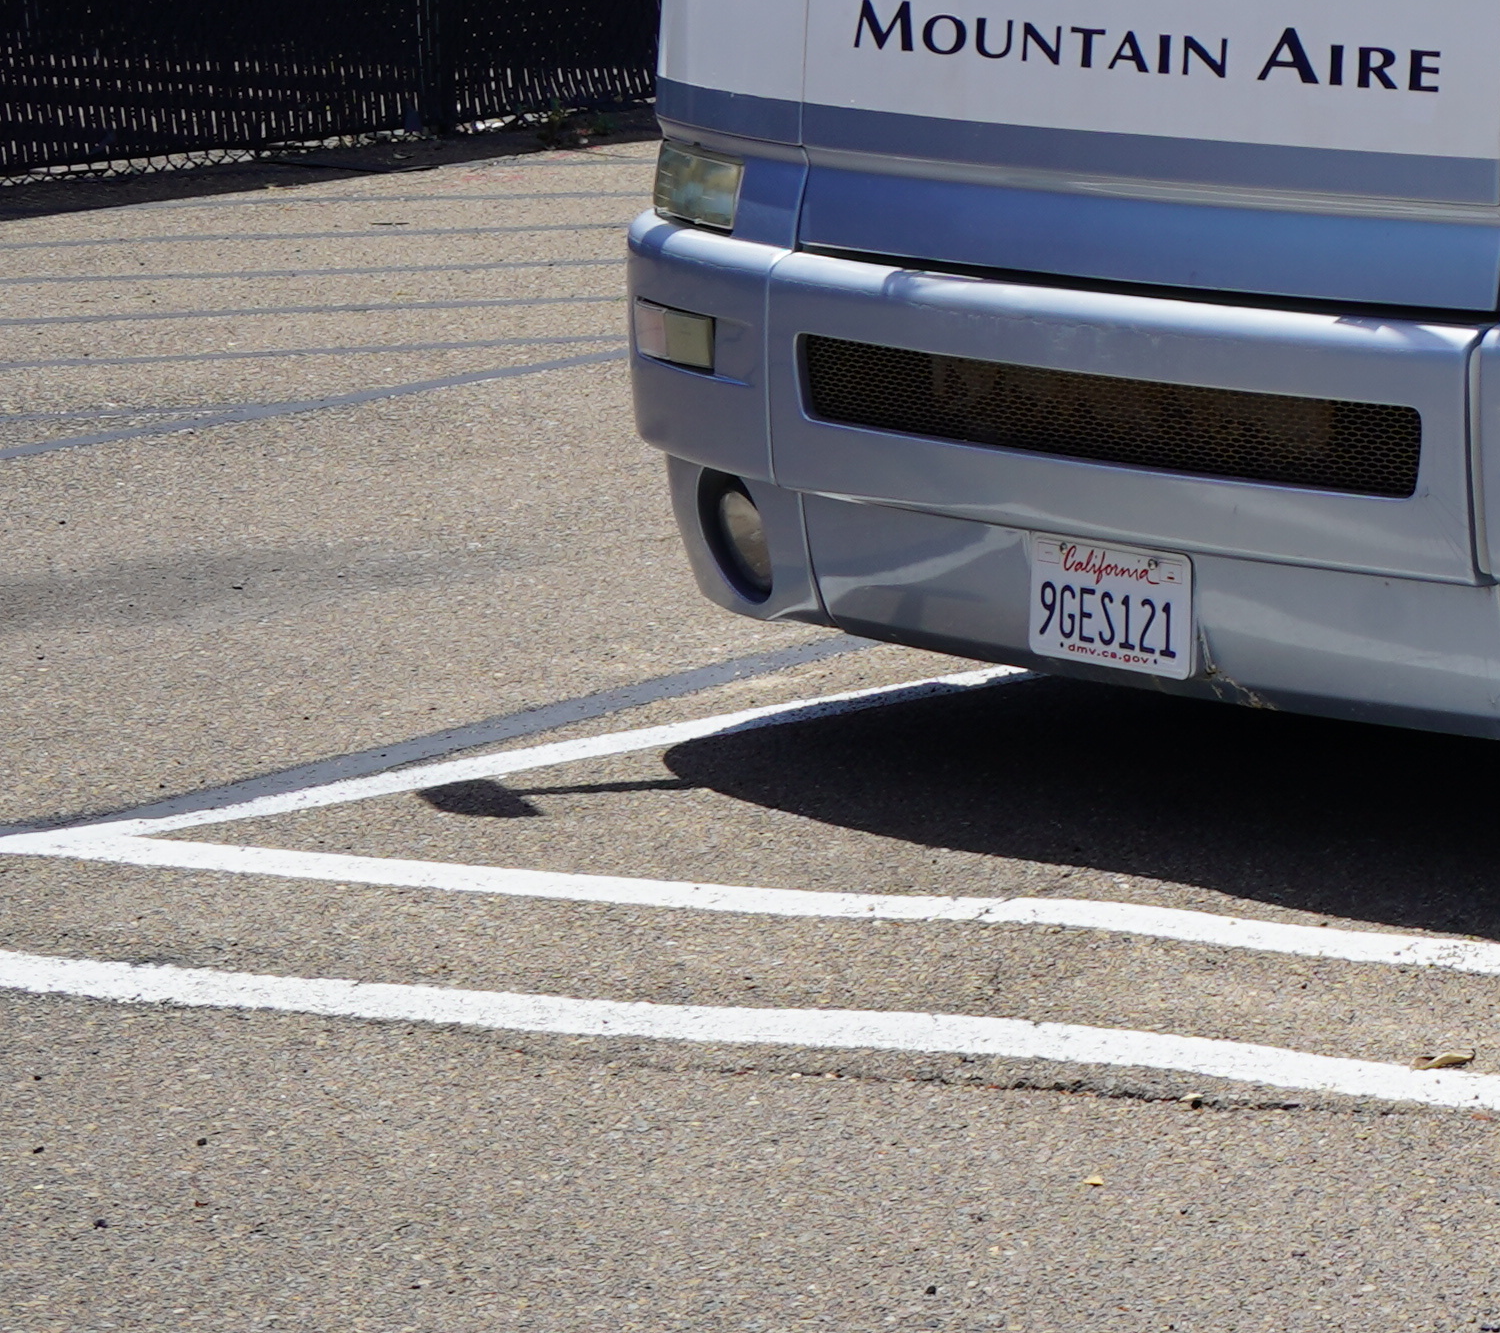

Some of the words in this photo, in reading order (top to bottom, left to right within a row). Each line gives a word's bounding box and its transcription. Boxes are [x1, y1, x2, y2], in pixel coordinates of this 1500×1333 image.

[1257, 27, 1442, 93] AIRE
[1064, 545, 1160, 585] California
[1039, 580, 1177, 659] 9GES121
[1068, 643, 1149, 665] dmv.ca.gov
